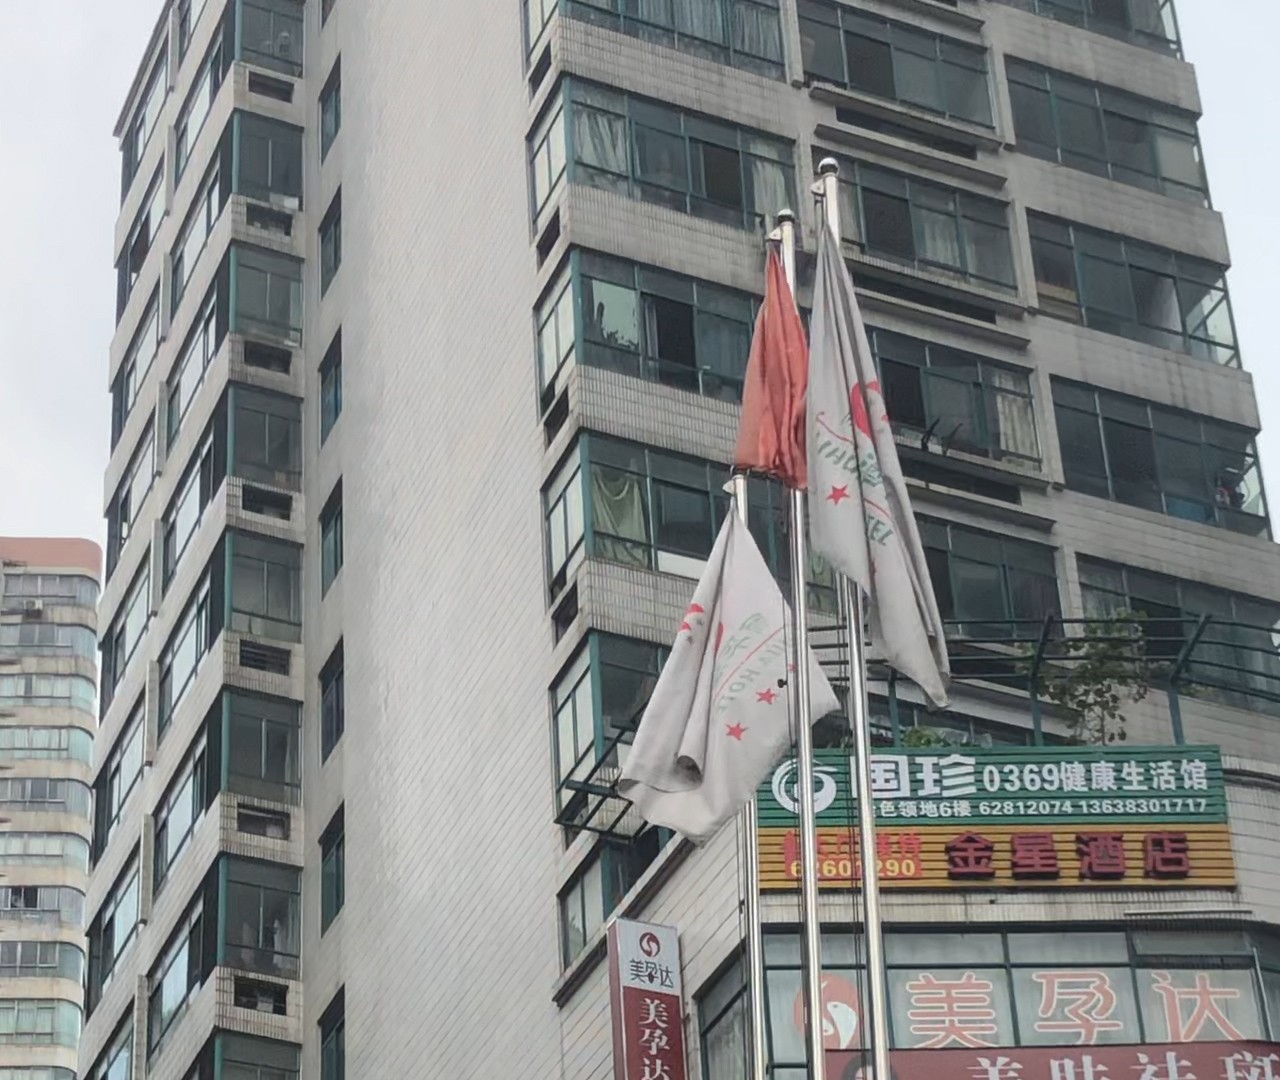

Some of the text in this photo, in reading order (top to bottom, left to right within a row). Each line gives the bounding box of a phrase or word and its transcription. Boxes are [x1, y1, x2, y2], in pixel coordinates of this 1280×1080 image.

[850, 754, 1208, 798] 国珍 0369健康生活馆
[869, 798, 1207, 818] 色领地6楼 62812074 13638301717
[944, 830, 1190, 881] 金星酒店
